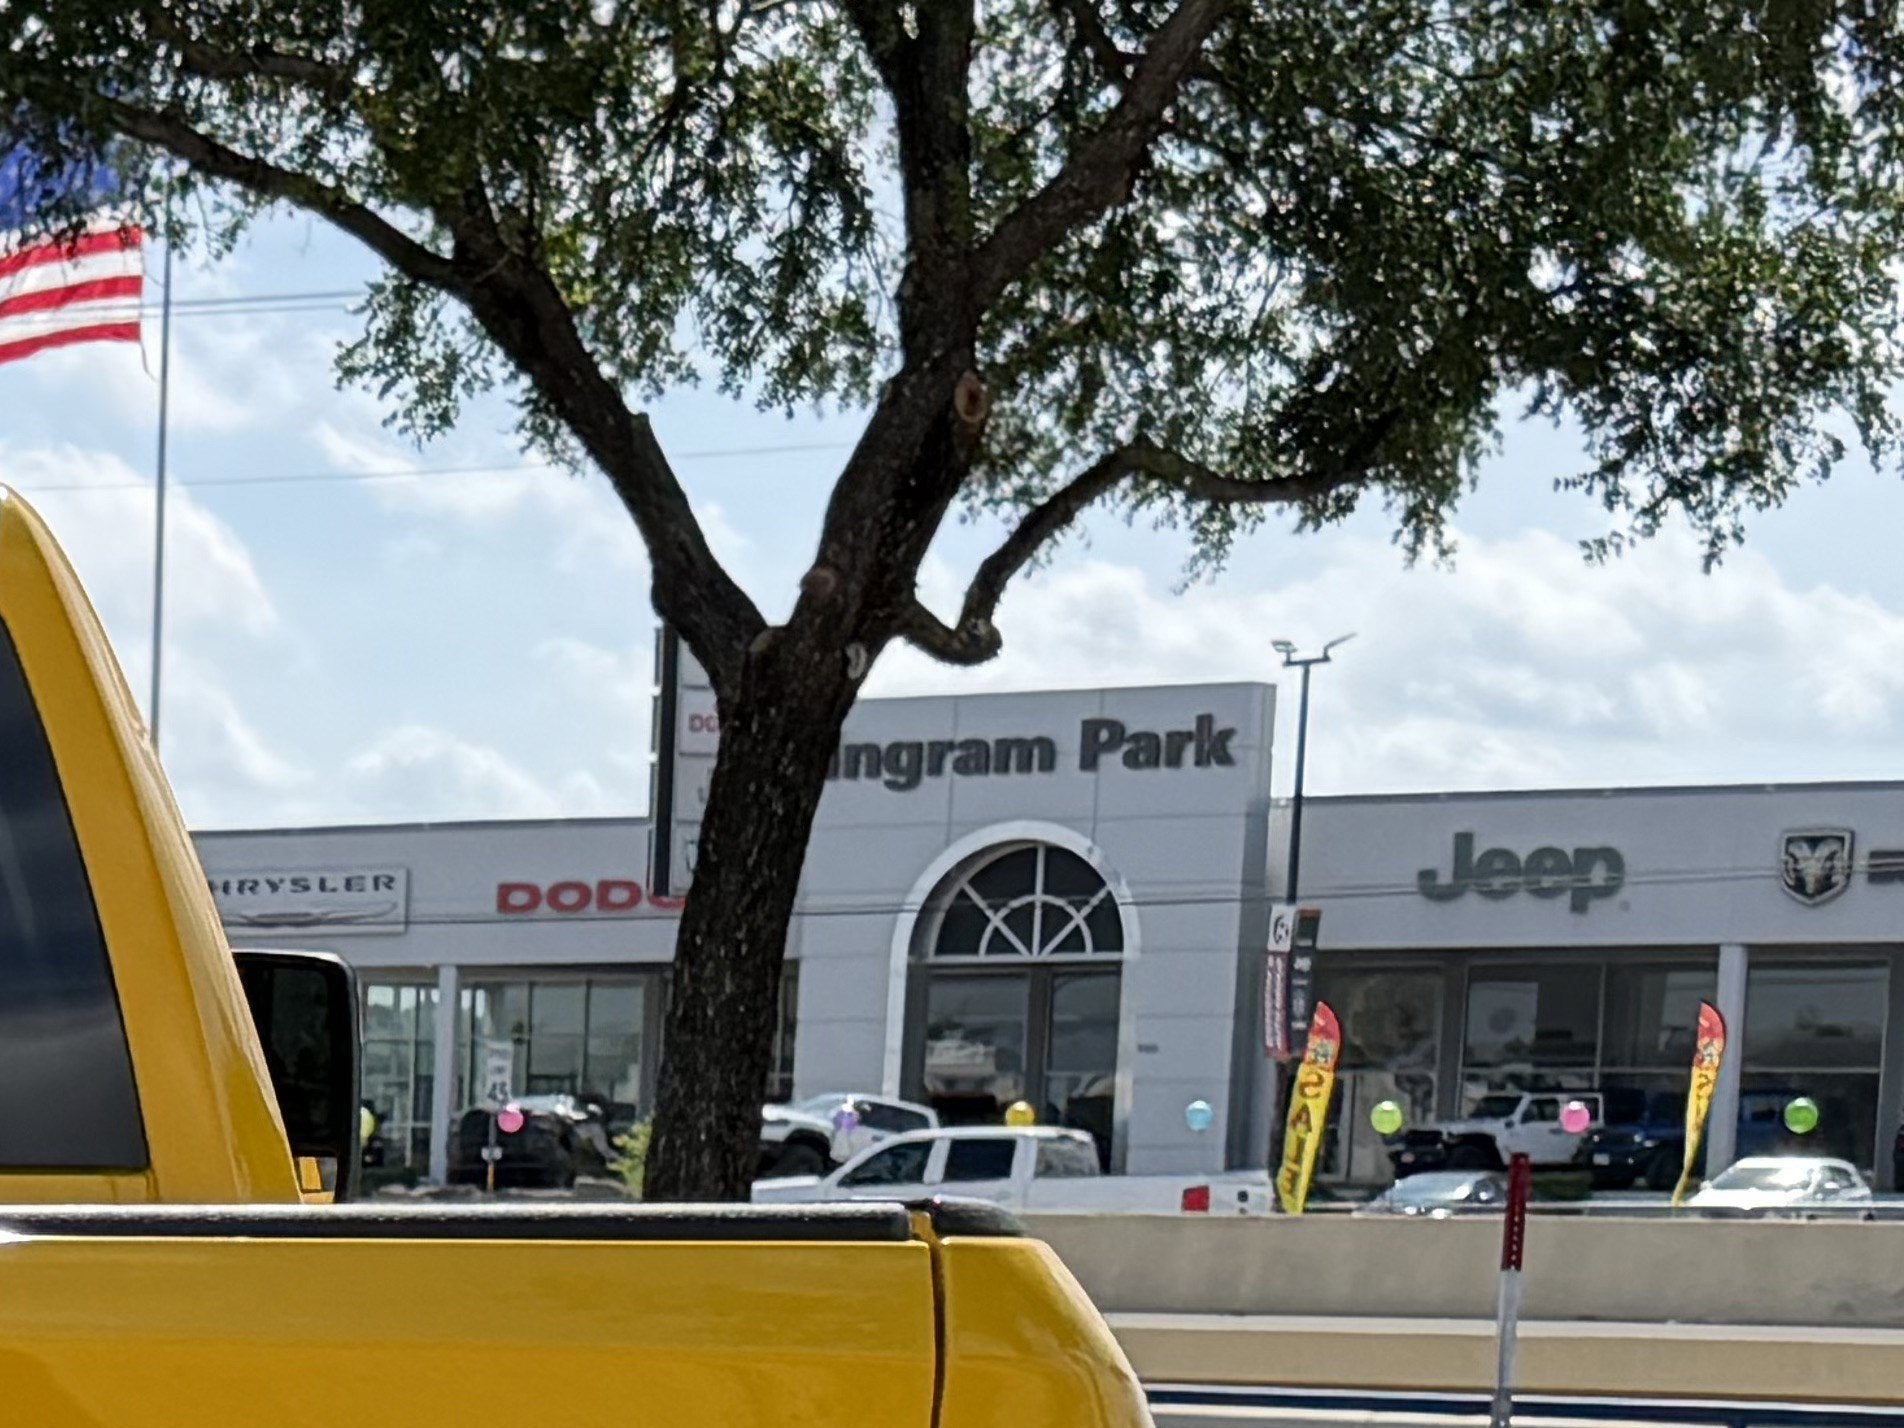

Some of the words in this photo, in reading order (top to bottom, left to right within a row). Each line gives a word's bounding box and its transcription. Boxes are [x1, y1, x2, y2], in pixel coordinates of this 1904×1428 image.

[1079, 713, 1237, 771] Park
[209, 874, 396, 895] HRYSLER
[1417, 832, 1625, 913] Jeep
[496, 879, 686, 914] DOD
